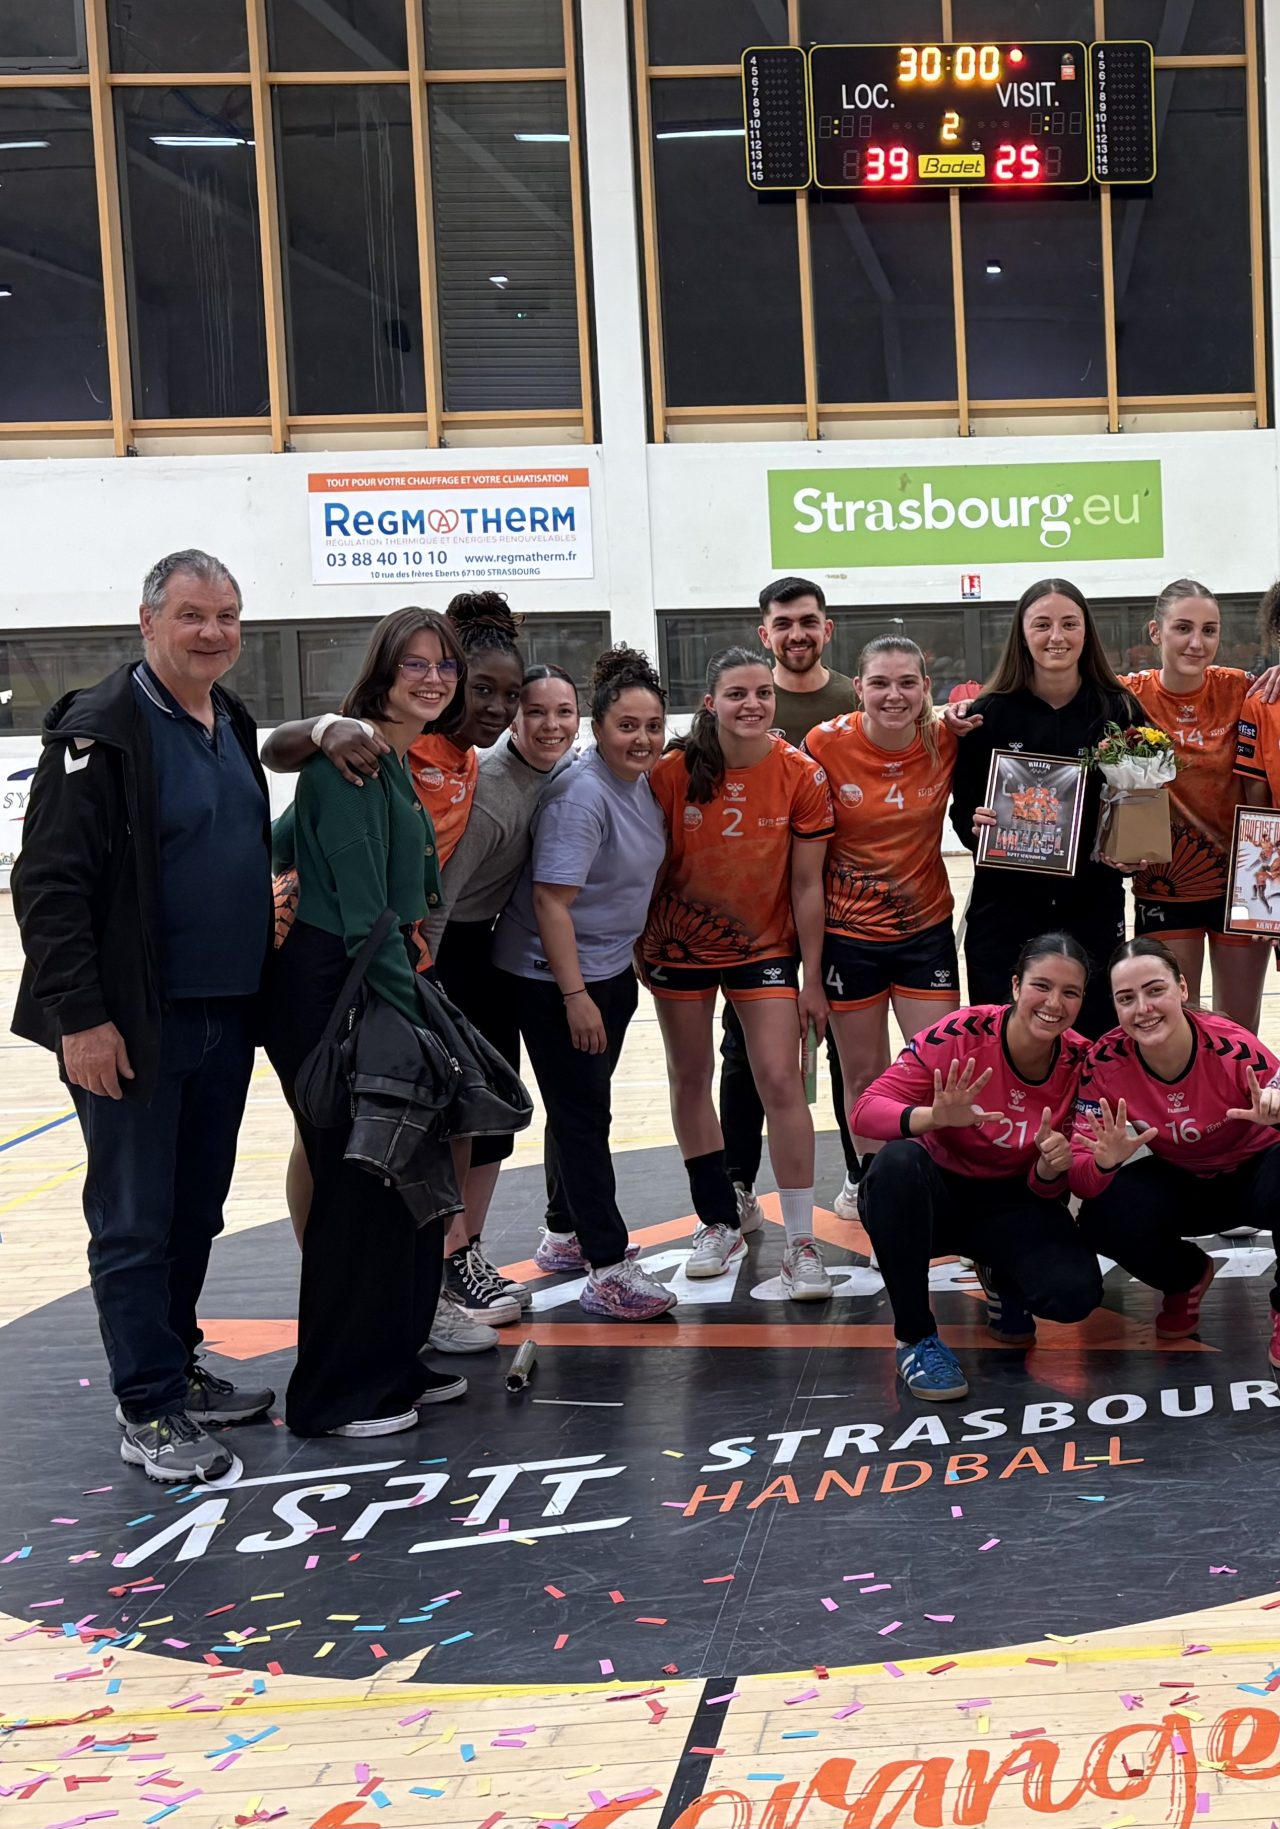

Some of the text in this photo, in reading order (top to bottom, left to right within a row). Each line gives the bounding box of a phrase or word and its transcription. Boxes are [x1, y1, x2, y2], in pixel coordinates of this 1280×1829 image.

[1097, 50, 1105, 59] 4
[750, 56, 757, 65] 4
[899, 47, 1000, 82] 30:00
[1098, 61, 1106, 70] 5
[751, 67, 758, 76] 5
[1098, 71, 1106, 80] 6
[751, 77, 759, 86] 6
[1098, 82, 1106, 91] 7
[752, 88, 759, 97] 7
[841, 82, 1060, 109] LOC. VISIT.
[1099, 92, 1106, 101] 8
[752, 98, 760, 107] 8
[1099, 102, 1106, 112] 9
[753, 109, 760, 118] 9
[1095, 113, 1107, 122] 10
[749, 119, 761, 128] 10
[942, 112, 960, 140] 2
[1096, 124, 1106, 133] 11
[749, 130, 760, 139] 11
[1096, 134, 1108, 143] 12
[750, 140, 762, 149] 12
[1096, 144, 1108, 154] 13
[750, 151, 762, 160] 13
[1096, 155, 1108, 164] 14
[751, 161, 763, 170] 14
[866, 144, 1040, 181] 39 Bodet 25
[1097, 165, 1109, 175] 15
[752, 171, 764, 180] 15
[326, 474, 569, 488] TOUT POUR VOTRE CHAUFFAGE ET VOTRE CLIMATISATION
[793, 484, 1140, 548] Strasbourg.eu
[440, 536, 450, 545] ET
[327, 550, 577, 567] 03 88 40 10 10 www.regmatherm.fr
[371, 571, 380, 579] 10
[396, 570, 409, 579] des
[411, 570, 433, 579] frères
[461, 569, 485, 577] 67100
[487, 567, 540, 577] STRASBOURG
[1173, 728, 1204, 747] 14
[884, 783, 905, 810] 4
[721, 807, 744, 837] 2
[825, 965, 844, 995] 4
[993, 1118, 1028, 1149] 21
[1165, 1118, 1201, 1144] 16
[682, 1436, 1145, 1518] HANDBALL
